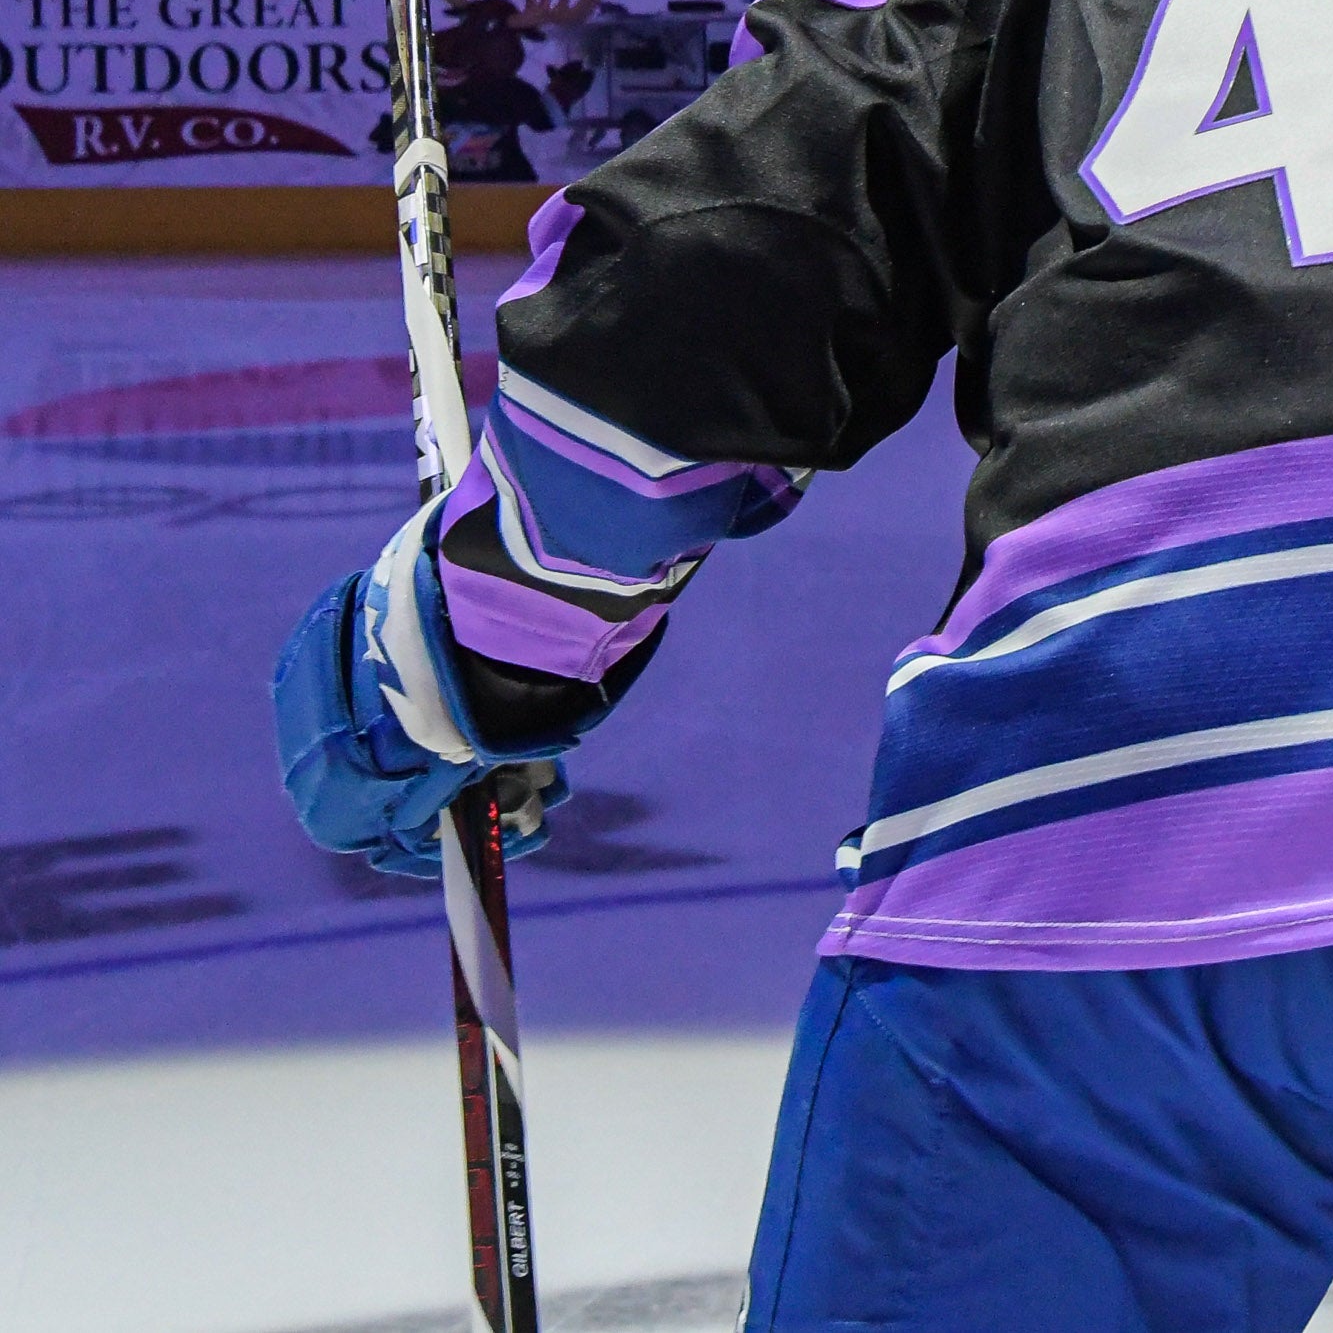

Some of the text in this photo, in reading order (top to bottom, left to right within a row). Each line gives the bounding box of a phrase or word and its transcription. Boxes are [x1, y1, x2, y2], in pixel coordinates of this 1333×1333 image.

[0, 41, 393, 95] UTDOORS
[73, 114, 281, 160] R.V. CO.
